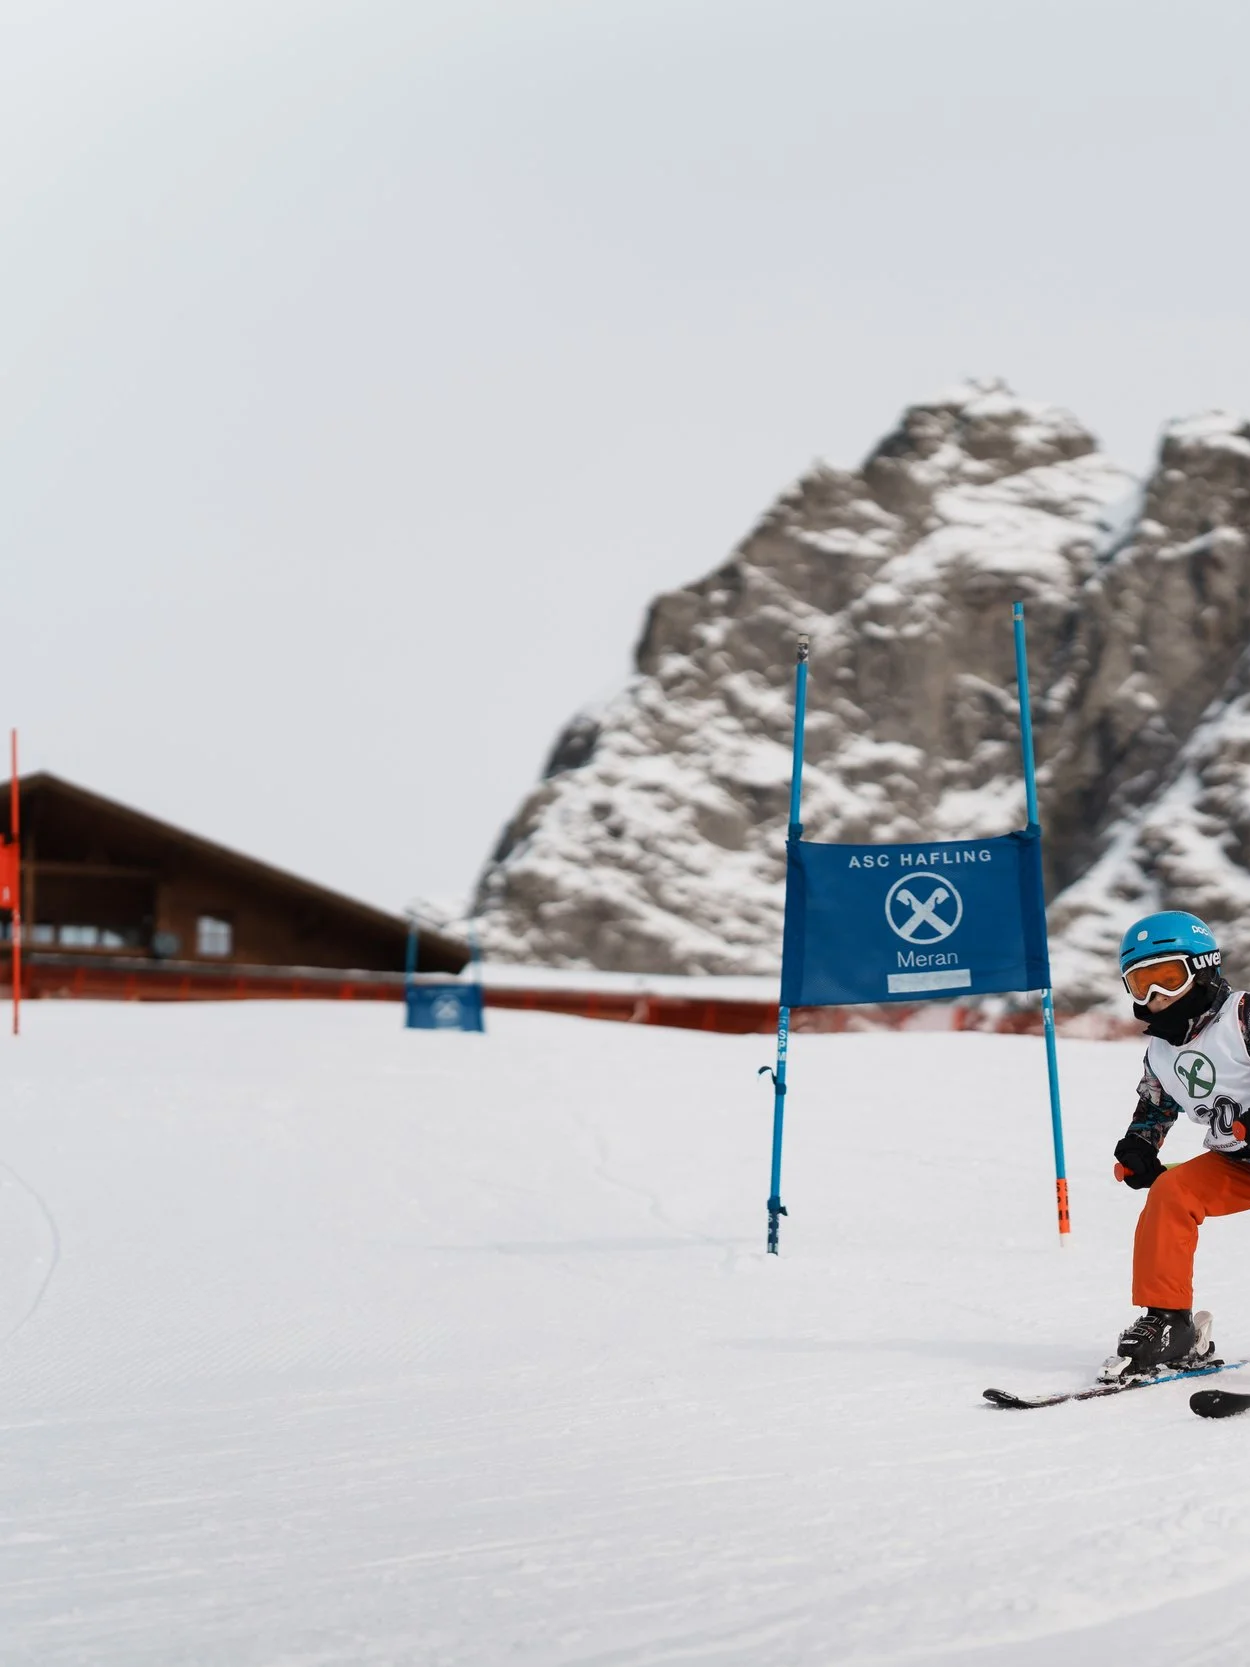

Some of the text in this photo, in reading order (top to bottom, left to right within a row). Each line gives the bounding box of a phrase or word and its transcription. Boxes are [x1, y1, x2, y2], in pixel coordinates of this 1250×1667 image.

[849, 850, 992, 868] ASC HAFLING
[897, 950, 958, 967] Meran
[1192, 952, 1221, 970] uve
